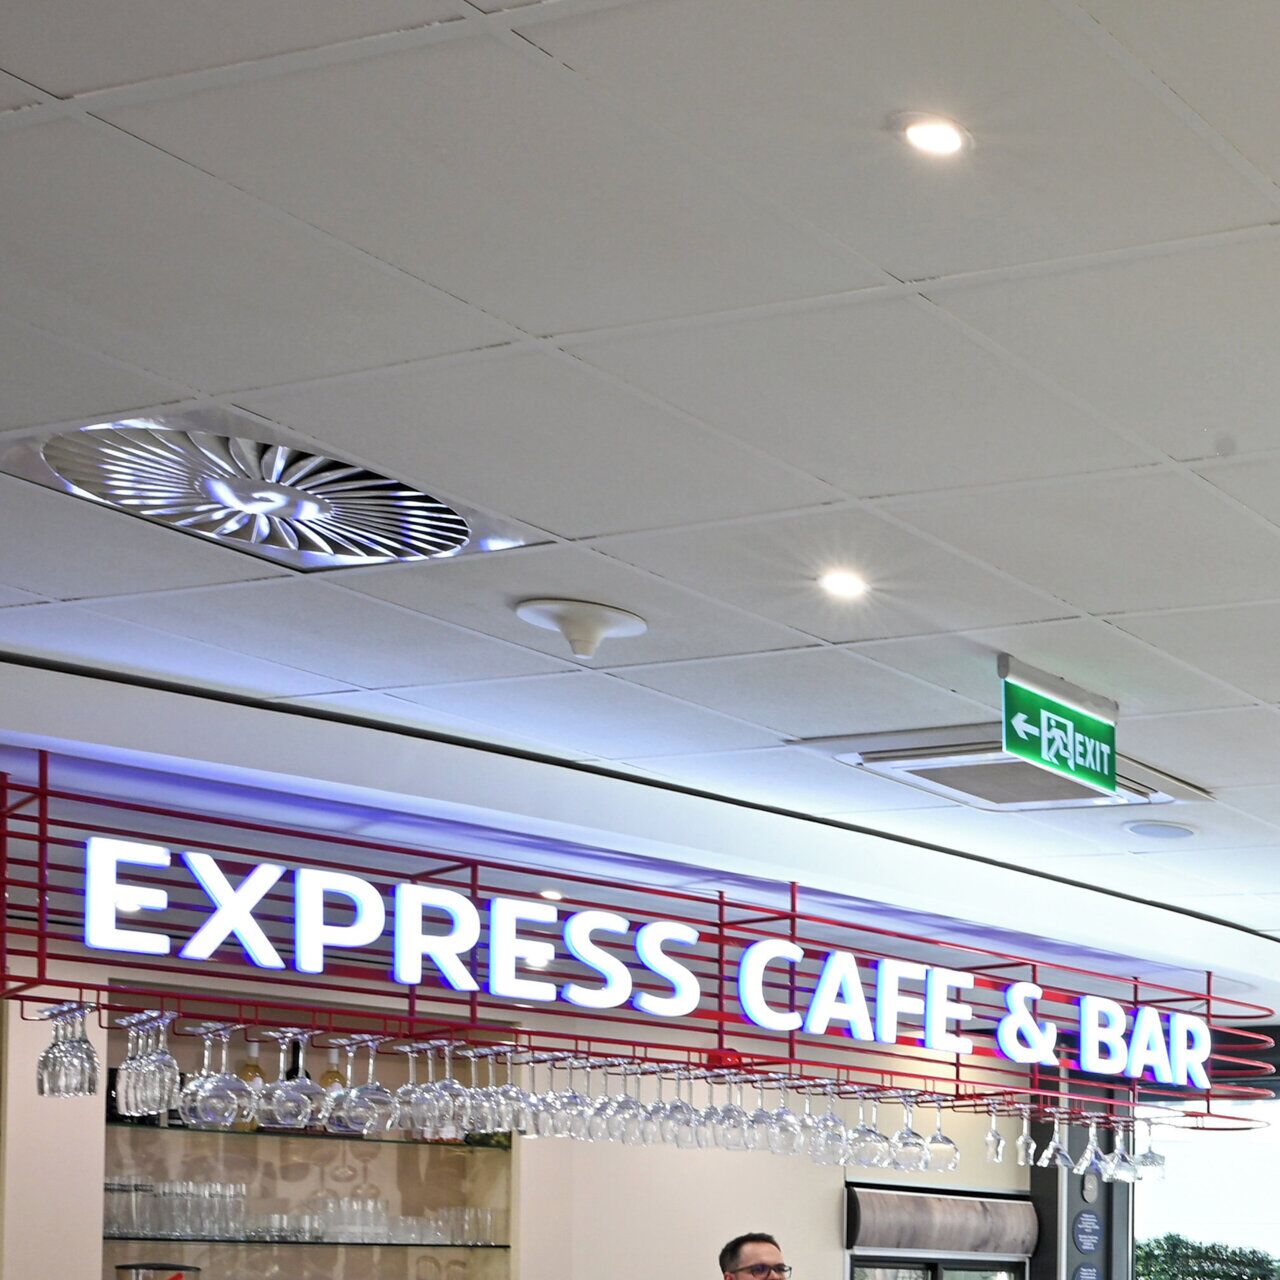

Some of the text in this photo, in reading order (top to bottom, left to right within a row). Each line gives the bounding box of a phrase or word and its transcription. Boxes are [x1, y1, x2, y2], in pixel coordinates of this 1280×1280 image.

[1075, 732, 1111, 776] EXIT
[84, 836, 1212, 1089] EXPRESS CAFE & BAR
